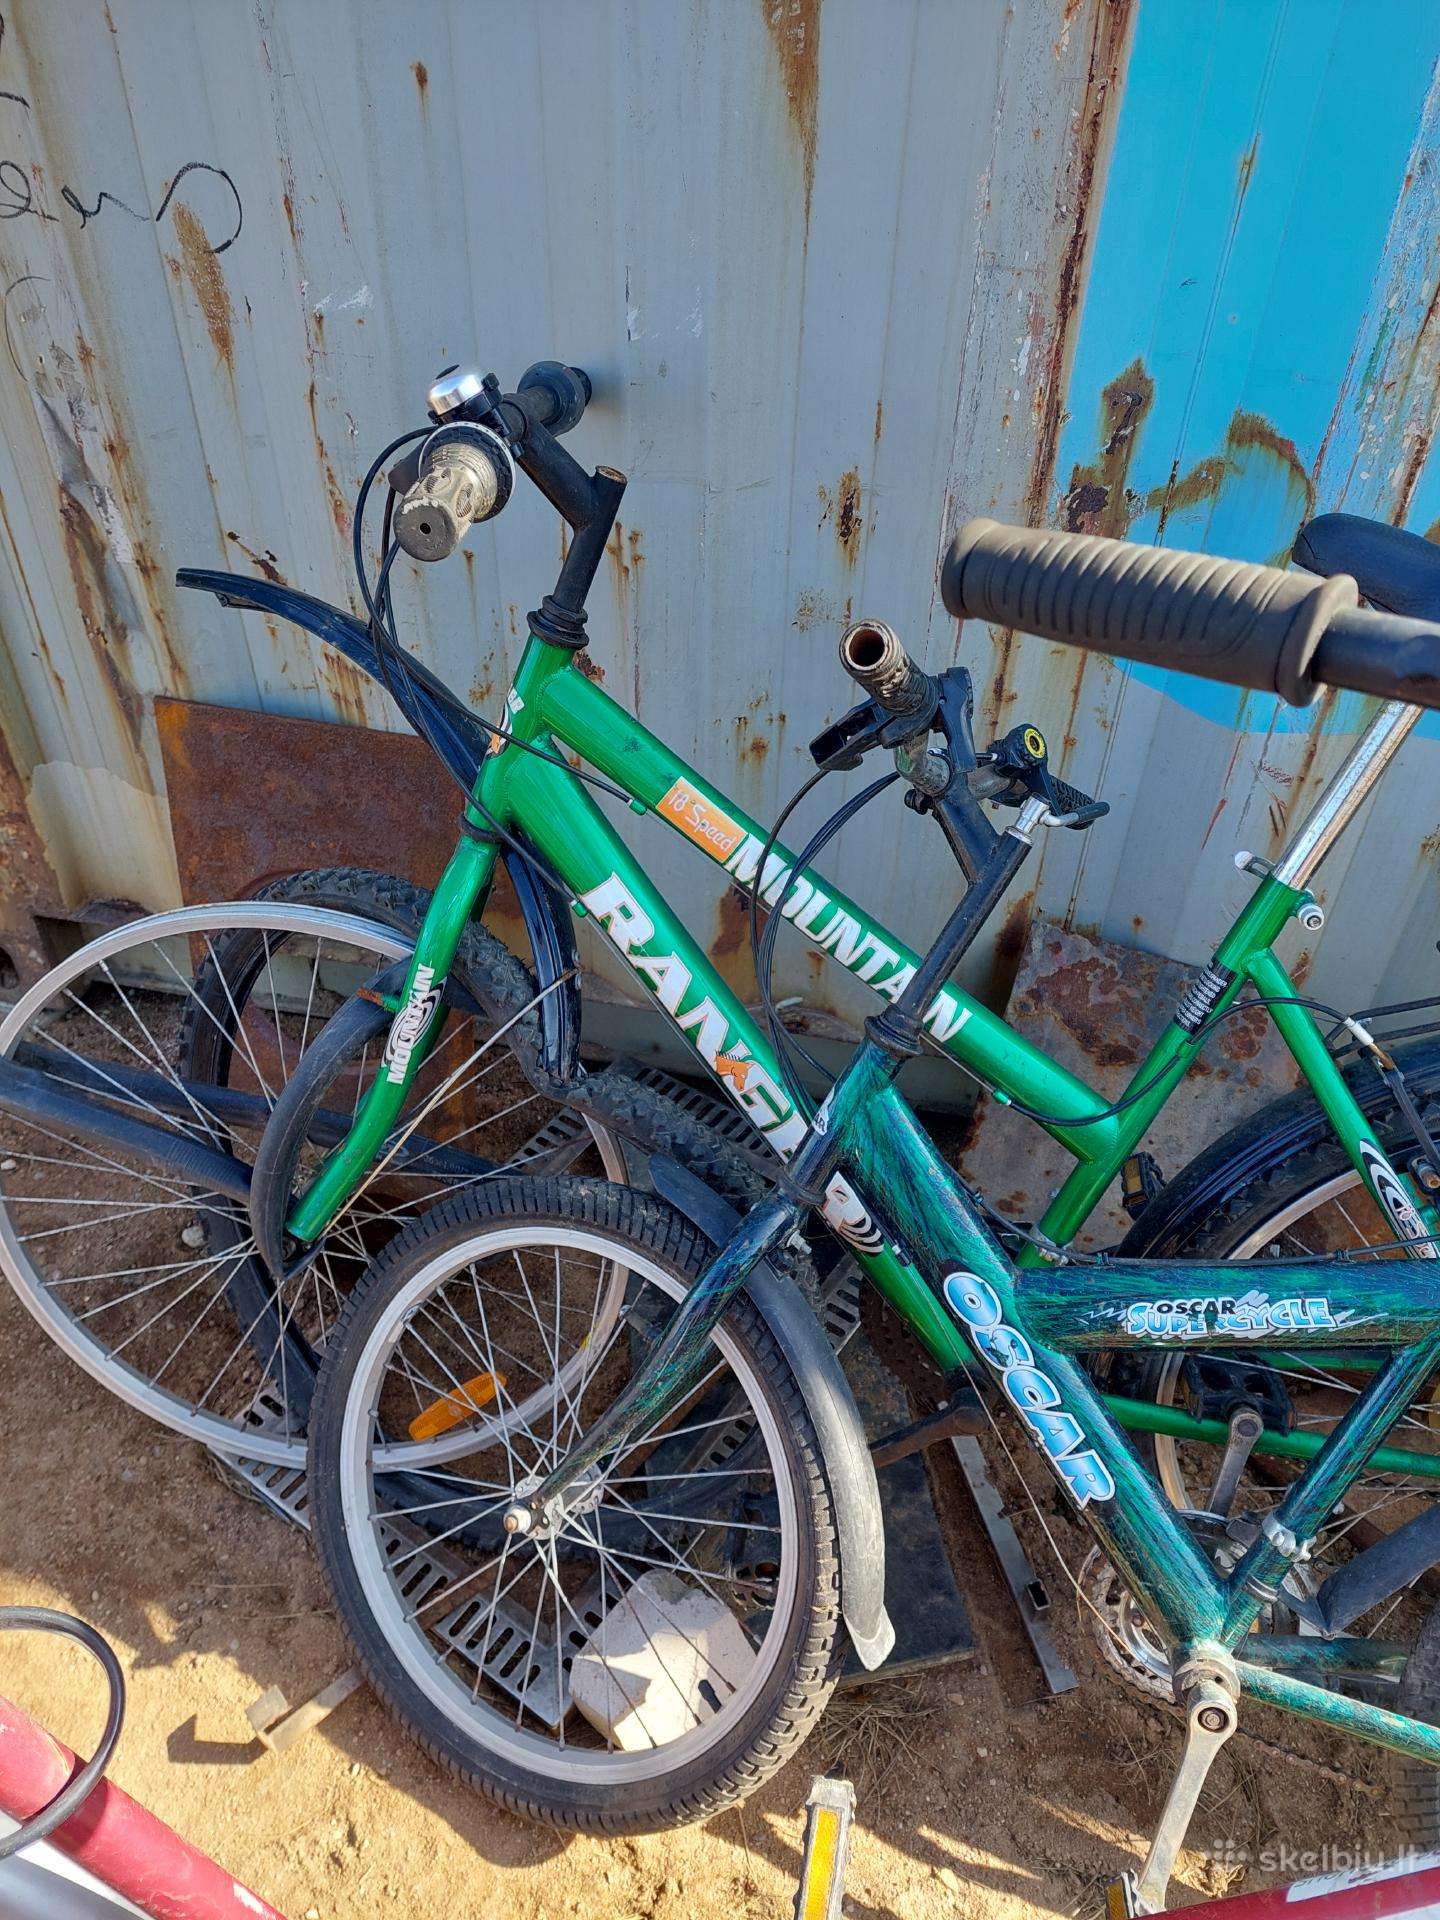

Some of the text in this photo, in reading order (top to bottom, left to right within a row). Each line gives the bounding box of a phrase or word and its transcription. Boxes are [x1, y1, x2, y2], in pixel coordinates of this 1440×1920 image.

[684, 802, 738, 853] Speed
[722, 832, 973, 1044] MOUNTAN
[1156, 1299, 1237, 1315] OSCAR
[944, 1272, 1115, 1508] OSCAR
